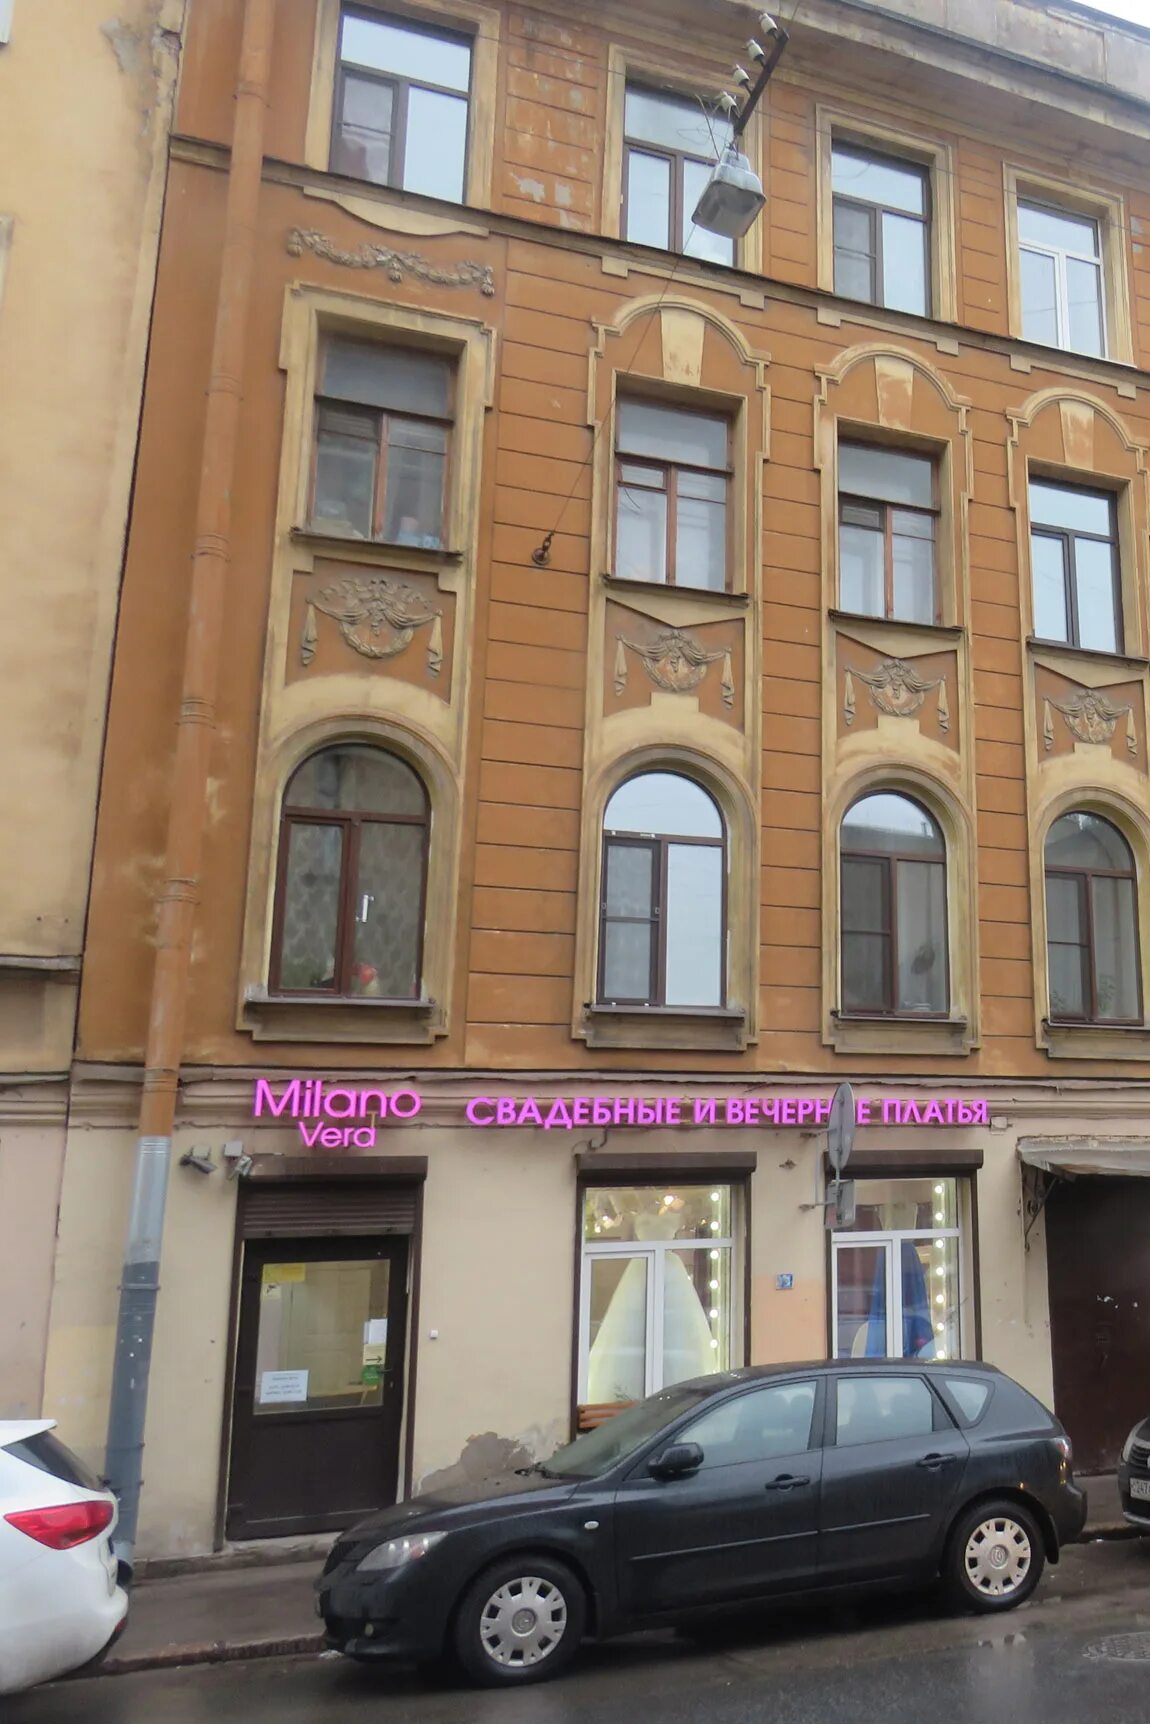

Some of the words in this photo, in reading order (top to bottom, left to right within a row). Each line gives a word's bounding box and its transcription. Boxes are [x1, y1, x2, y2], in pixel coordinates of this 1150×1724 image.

[254, 1079, 422, 1118] Milano
[465, 1096, 681, 1130] СВАДЕБНЫЕ
[693, 1097, 717, 1125] И
[725, 1098, 871, 1125] ВЕЧЕРНЕ
[881, 1098, 989, 1125] ПЛАТЬЯ
[297, 1120, 377, 1148] Vera
